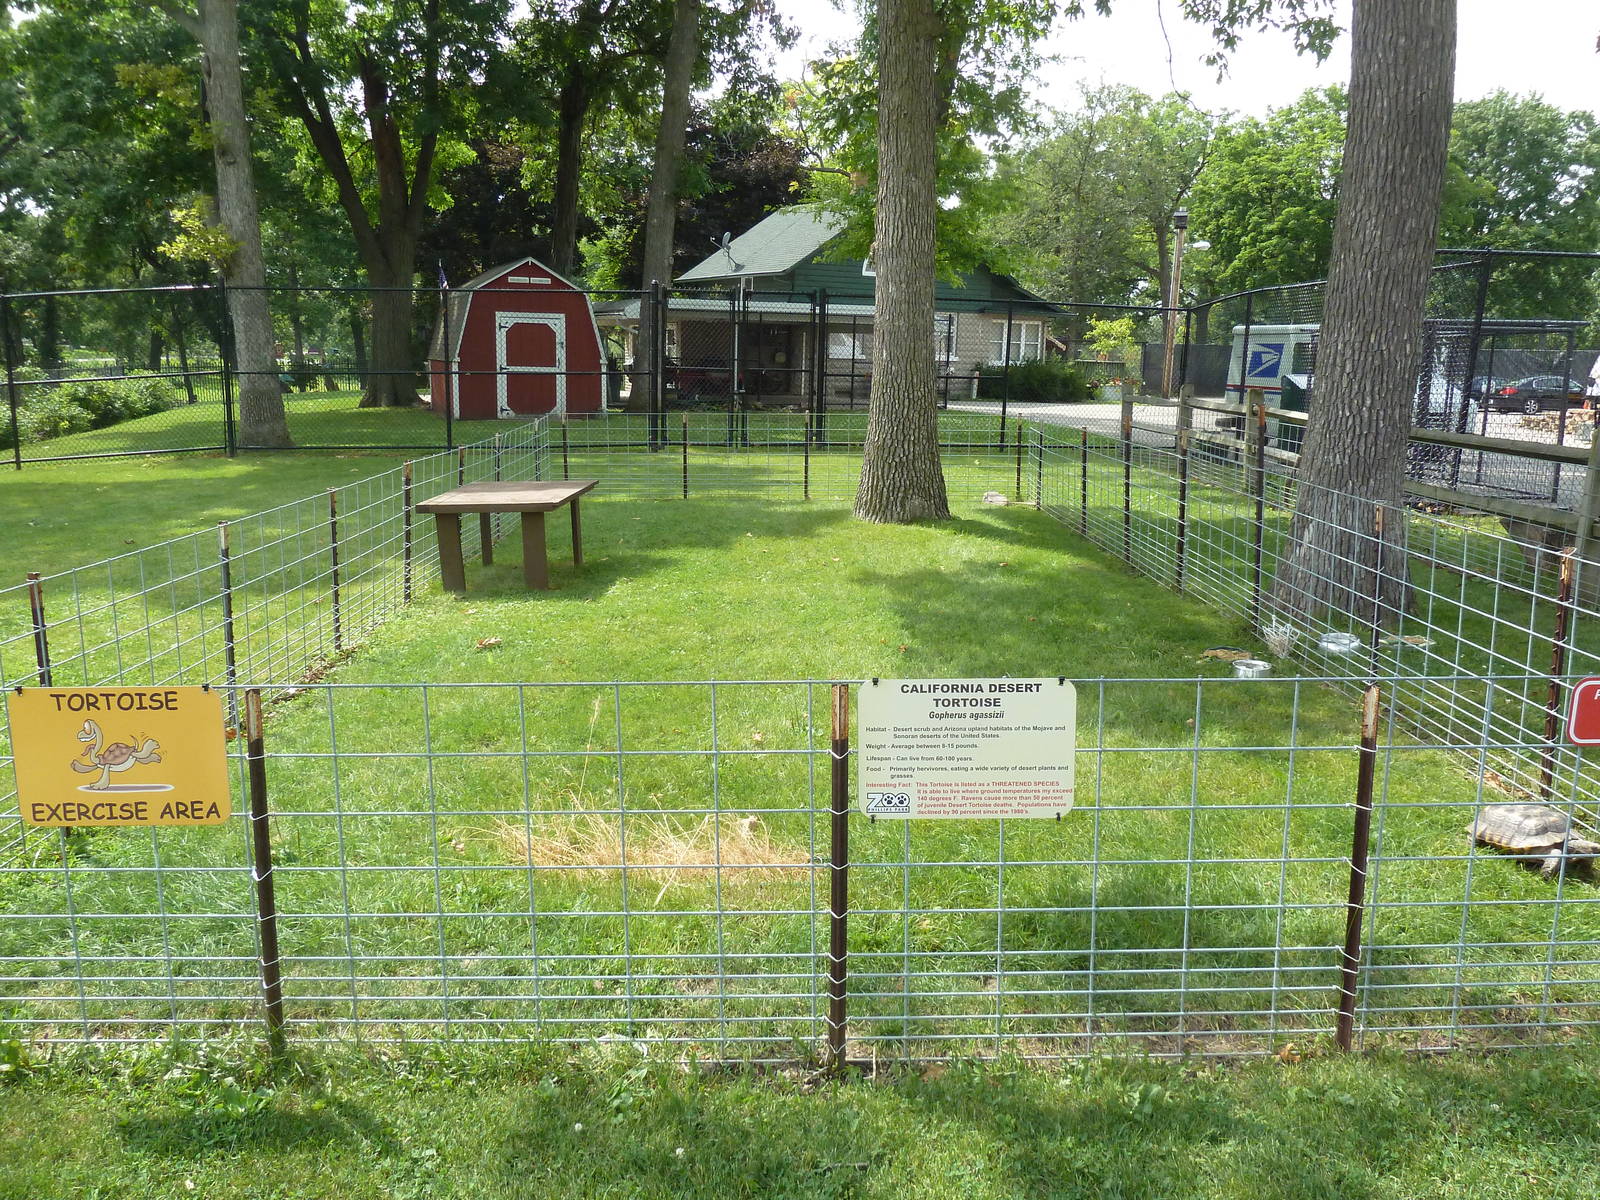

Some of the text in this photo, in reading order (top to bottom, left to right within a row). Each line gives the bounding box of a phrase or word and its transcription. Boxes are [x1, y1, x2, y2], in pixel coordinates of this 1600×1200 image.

[901, 684, 1042, 693] CALIFORNIA DESERT
[50, 691, 178, 711] TORTOISE
[933, 698, 1001, 707] TORTOISE
[929, 711, 1004, 720] Gopherus agassizii
[32, 800, 220, 822] EXERCISE AREA
